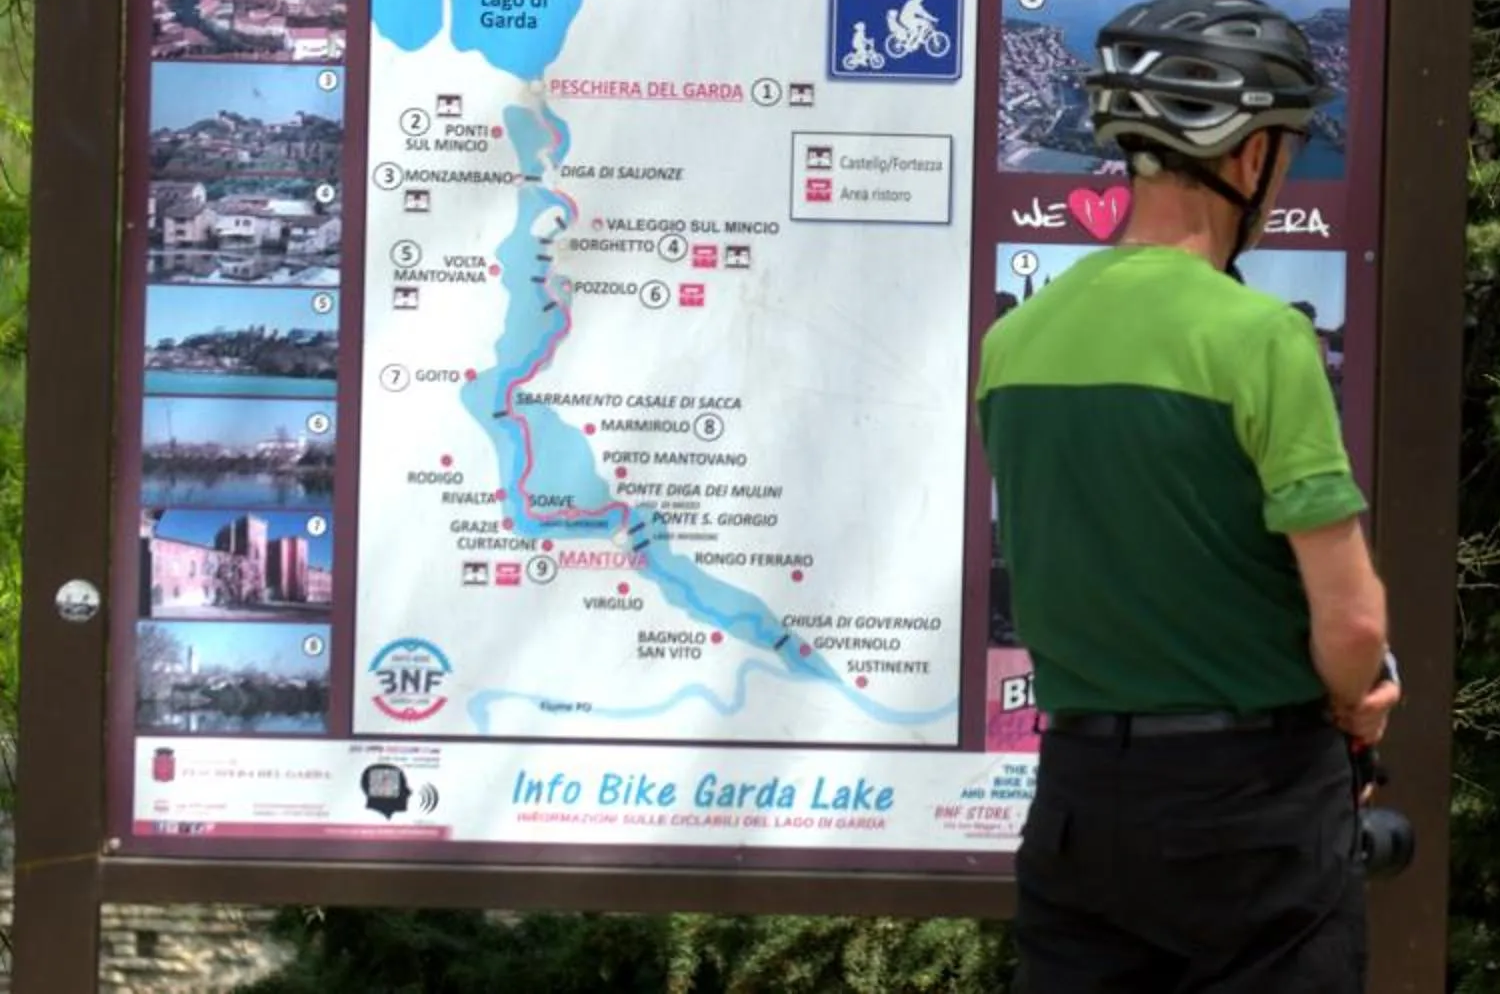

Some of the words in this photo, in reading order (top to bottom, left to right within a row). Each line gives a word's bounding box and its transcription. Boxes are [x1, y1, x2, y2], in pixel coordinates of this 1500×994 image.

[481, 12, 537, 29] Garda
[551, 79, 641, 96] PESCHIERA
[648, 81, 679, 97] DEL
[683, 83, 744, 100] GARDA
[445, 124, 489, 137] PONTI
[405, 139, 430, 151] SUL
[435, 140, 489, 152] MINCIO
[404, 170, 514, 184] MONZAMBANO
[561, 165, 595, 178] DIGA
[600, 166, 614, 179] DI
[607, 218, 686, 232] VALEGGIO
[690, 220, 720, 233] SUL
[725, 221, 780, 234] MINCIO
[570, 238, 654, 252] BORGHETTO
[444, 256, 486, 268] VOLTA
[393, 269, 486, 283] MANTOVANA
[575, 281, 638, 294] POZZOLO
[415, 369, 460, 382] GOITO
[516, 392, 622, 406] SBARRAMENTO
[625, 394, 677, 408] CASALE
[682, 396, 696, 409] DI
[699, 396, 742, 409] SACCA
[601, 419, 690, 433] MARMIROLO
[603, 451, 649, 464] PORTO
[653, 453, 747, 467] MANTOVANO
[407, 471, 464, 485] RODIGO
[616, 482, 662, 496] PONTE
[667, 483, 701, 496] DIGA
[705, 484, 727, 497] DEI
[442, 492, 497, 505] RIVALTA
[450, 520, 499, 533] GRAZIE
[652, 512, 697, 525] PONTE
[717, 513, 778, 527] GIORGIO
[457, 538, 538, 551] CURTATONE
[559, 551, 648, 568] MANTOVA
[637, 630, 706, 645] BAGNOLO
[813, 636, 901, 651] GOVERNOLO
[670, 647, 702, 660] VITO
[848, 659, 930, 675] SUSTINENTE
[512, 770, 580, 806] Info
[598, 773, 677, 807] Bike
[694, 774, 796, 810] Garda
[810, 776, 894, 812] Lake
